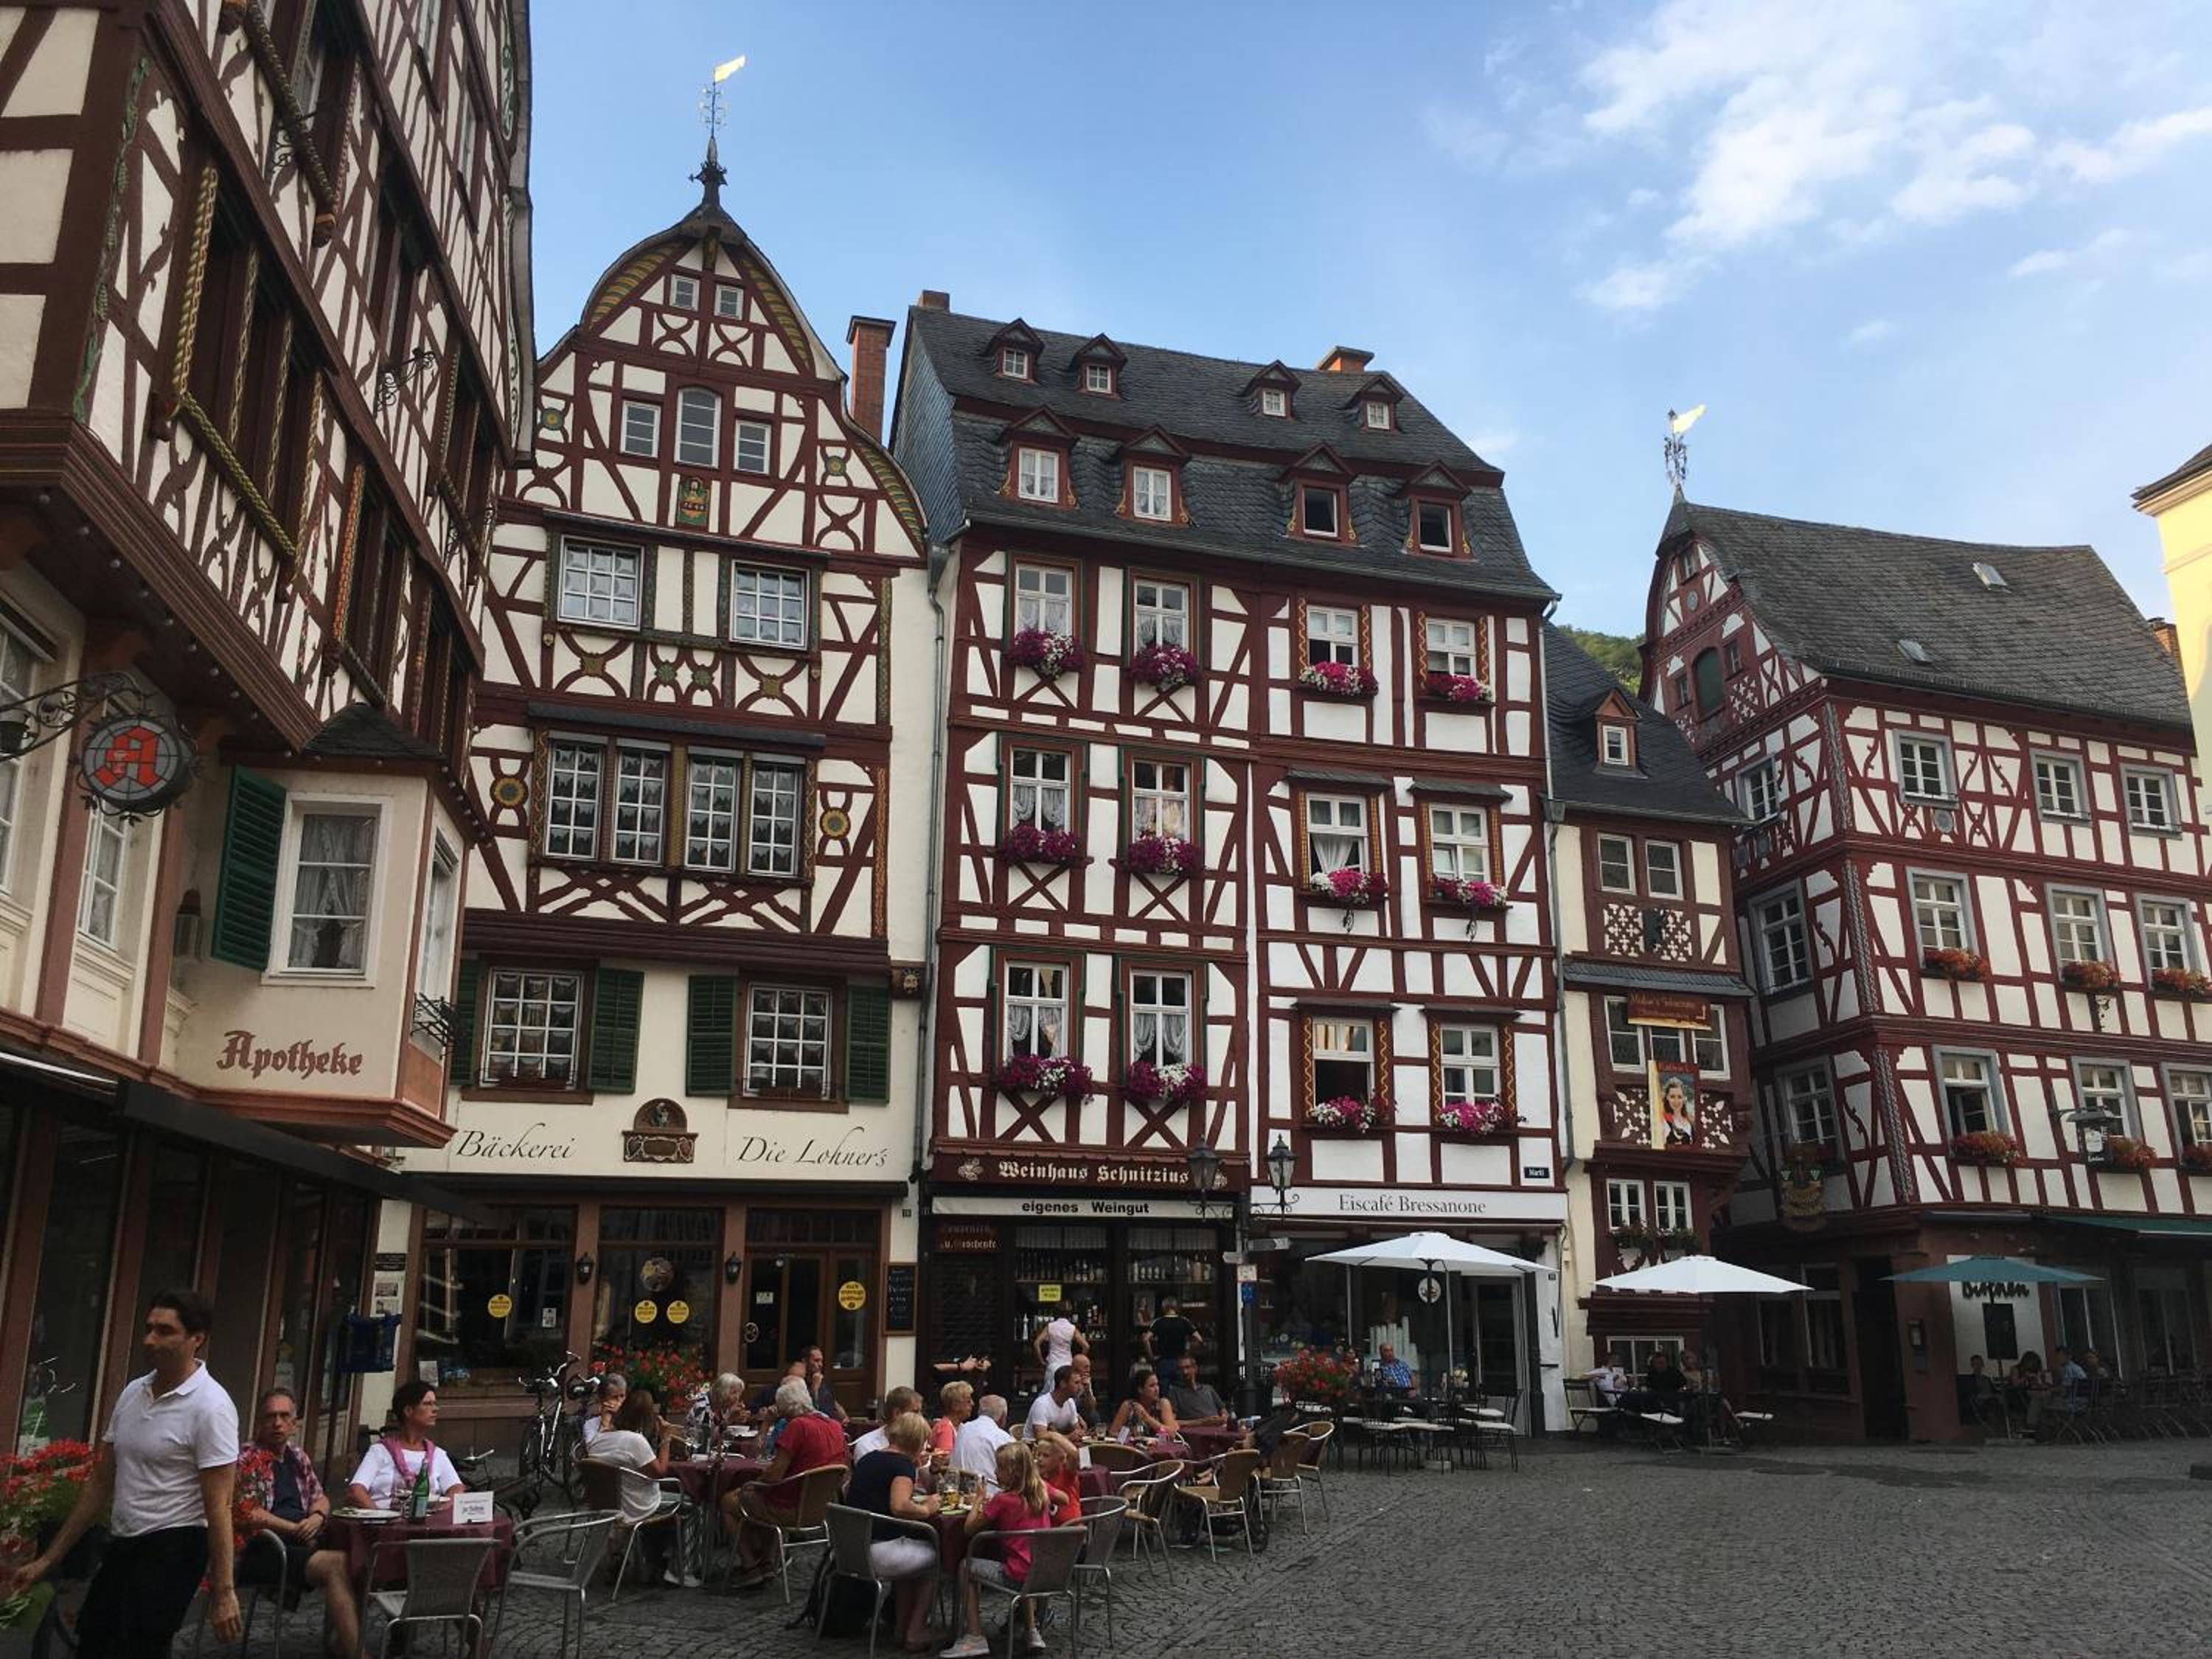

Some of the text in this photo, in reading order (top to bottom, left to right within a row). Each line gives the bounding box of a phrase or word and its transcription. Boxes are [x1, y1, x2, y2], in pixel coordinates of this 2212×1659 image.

[216, 1030, 363, 1080] Apotheke
[456, 1122, 577, 1159] Bäckerei
[737, 1136, 787, 1163] Die
[998, 1161, 1190, 1184] Weinhaus Schnitzius
[1021, 1201, 1150, 1214] eigenes Weingut
[1339, 1194, 1486, 1214] Eiscafé Bressanone
